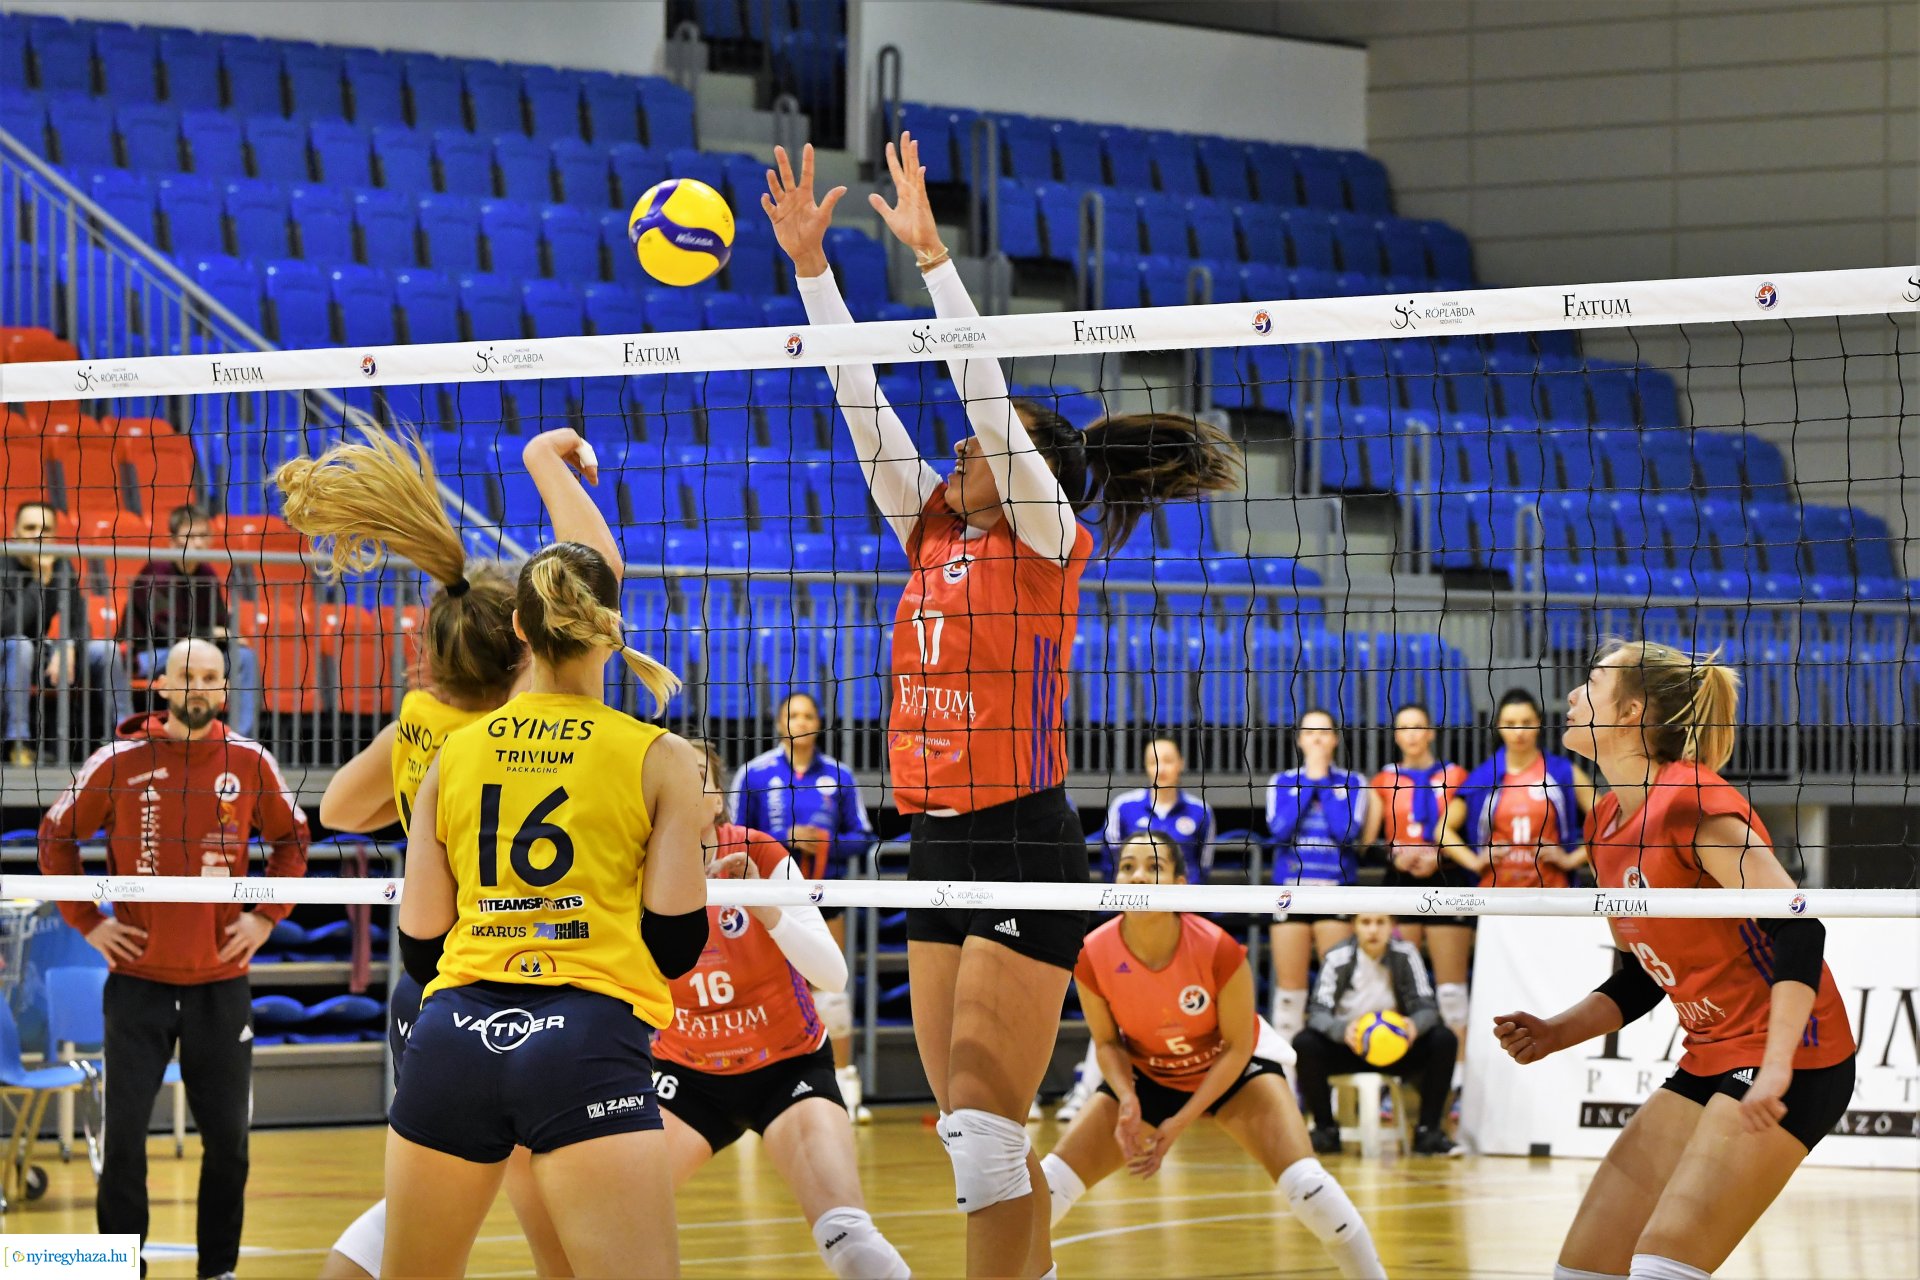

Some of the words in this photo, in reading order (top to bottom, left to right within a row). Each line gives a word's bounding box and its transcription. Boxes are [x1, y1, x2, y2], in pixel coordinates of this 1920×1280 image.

[1425, 306, 1475, 319] RÖPLABDA
[1562, 293, 1632, 317] FATUM
[1072, 318, 1136, 342] FATUM
[623, 341, 680, 363] FATUM
[211, 361, 264, 382] FATUM
[912, 609, 945, 666] 17
[898, 674, 977, 714] FATUM
[487, 716, 595, 741] GYIMES
[496, 749, 574, 765] TRIVIUM
[506, 766, 558, 774] PACKAGING
[478, 783, 574, 887] 16
[1099, 888, 1150, 906] FATUM
[1593, 893, 1649, 912] FATUM
[471, 925, 527, 938] IKARUS
[689, 970, 735, 1007] 16
[452, 1012, 565, 1037] VATNER
[675, 1004, 768, 1032] FATUM
[1165, 1036, 1194, 1056] 5
[606, 1095, 644, 1111] ZAEV
